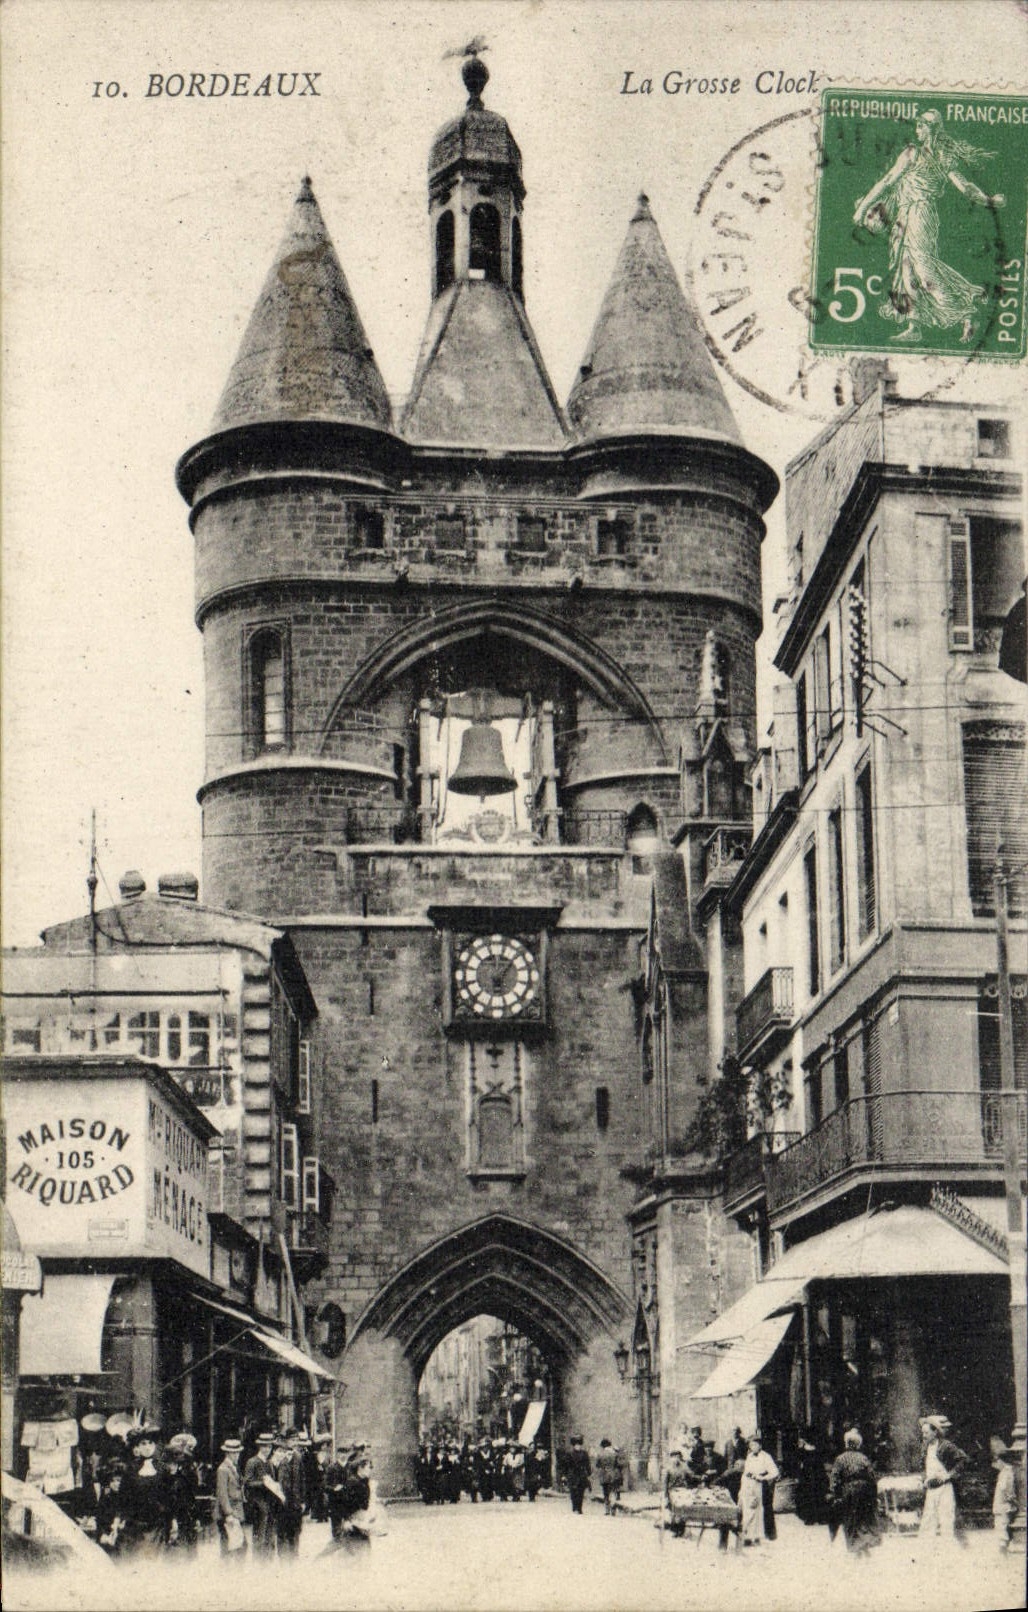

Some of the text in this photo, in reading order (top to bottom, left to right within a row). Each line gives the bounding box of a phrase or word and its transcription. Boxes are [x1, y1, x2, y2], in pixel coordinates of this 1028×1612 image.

[946, 103, 1028, 125] FRANÇAISE
[997, 258, 1022, 343] POSTES
[18, 1118, 131, 1154] MAISON
[10, 1163, 136, 1207] RIQUARD
